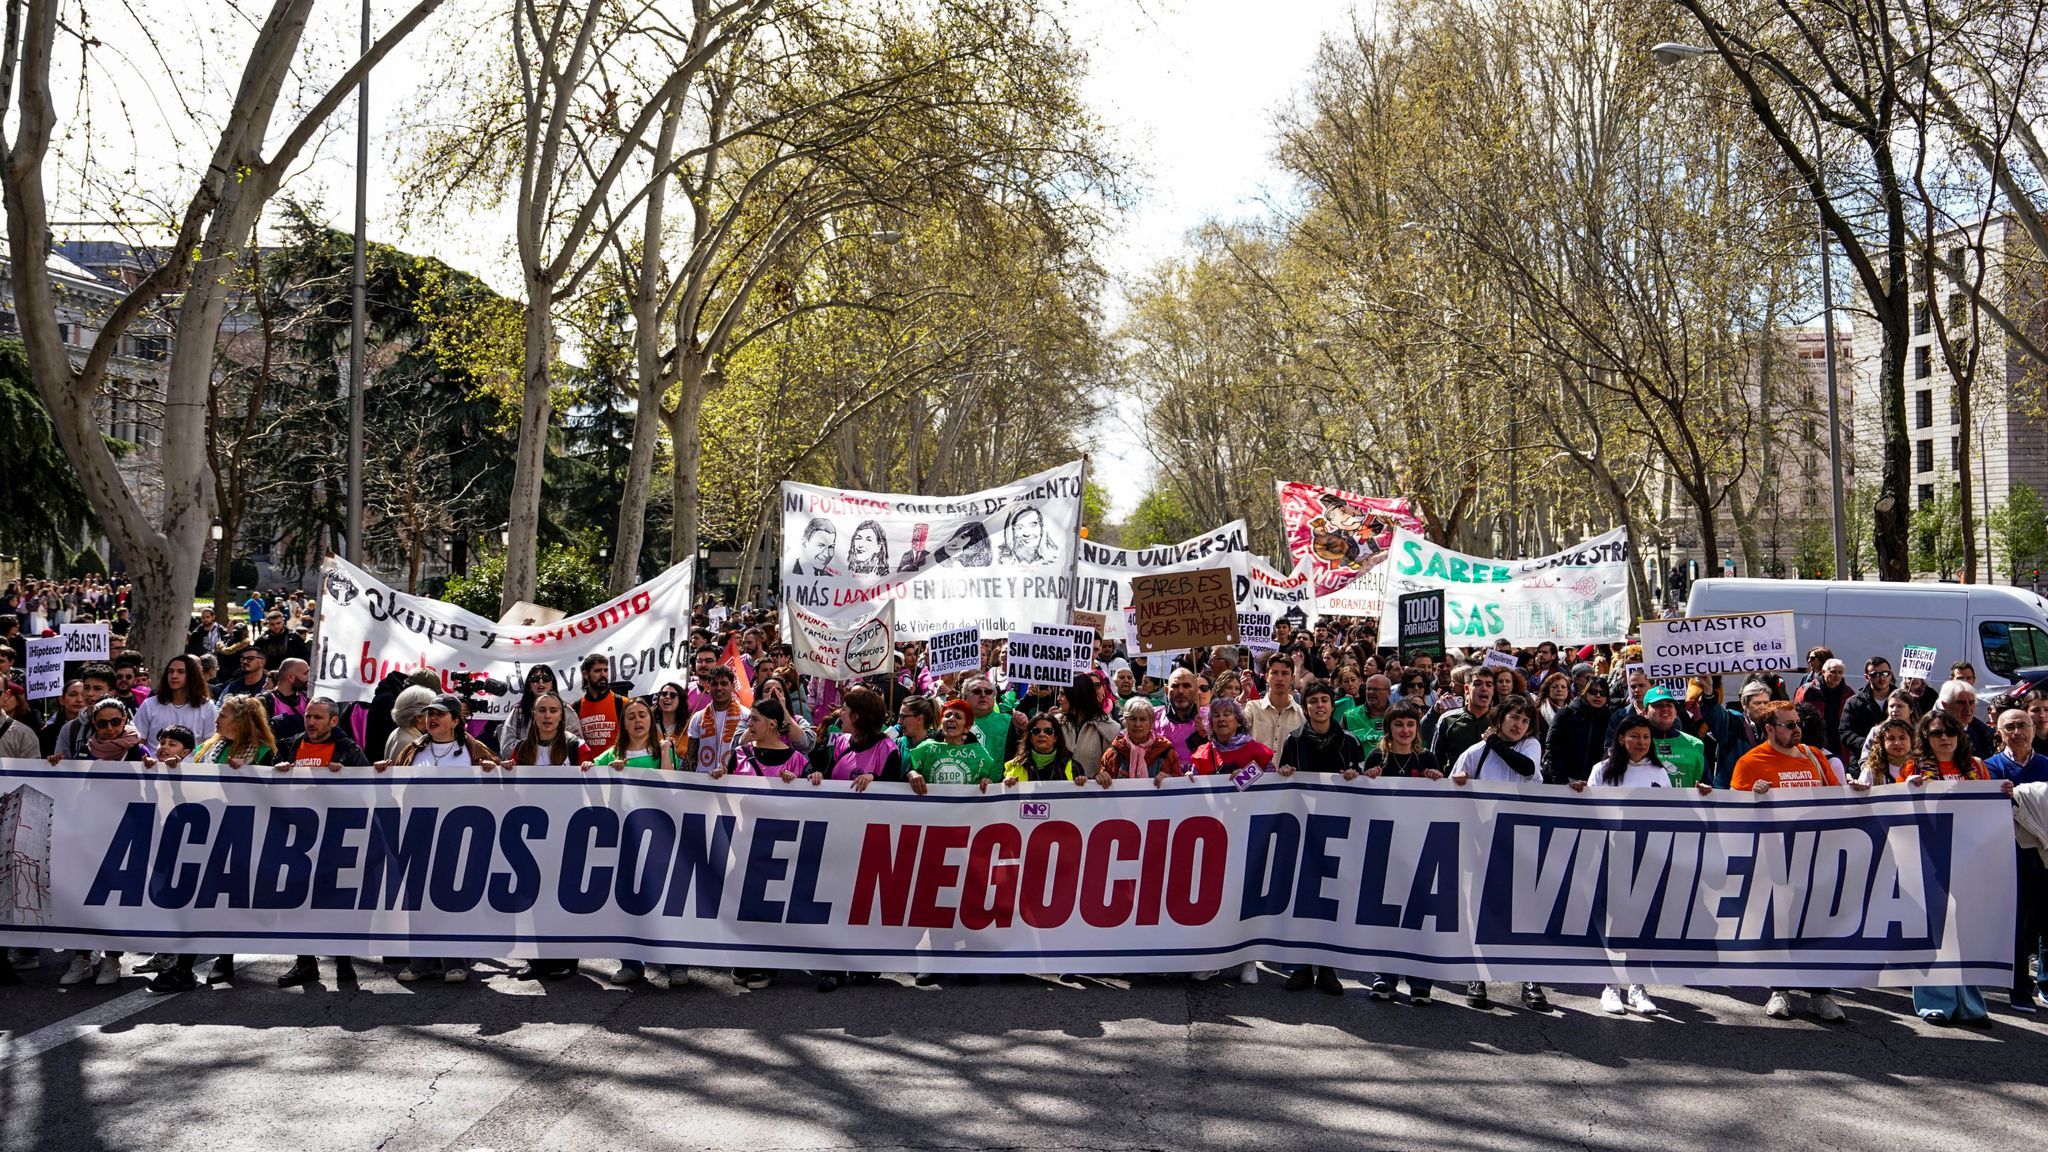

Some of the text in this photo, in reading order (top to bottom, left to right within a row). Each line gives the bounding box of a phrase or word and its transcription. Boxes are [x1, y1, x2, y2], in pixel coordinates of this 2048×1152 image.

[786, 492, 804, 512] NI
[1138, 529, 1249, 567] UNIVERSAL
[1137, 576, 1194, 600] SAREB
[1198, 574, 1223, 593] ES
[1251, 568, 1308, 589] IVIENDA
[796, 580, 829, 606] MÁS
[833, 582, 907, 607] LADRILLO
[914, 579, 935, 600] EN
[1006, 576, 1017, 598] Y
[1253, 586, 1310, 602] NIVERSAL
[1238, 613, 1271, 626] RECHO
[1404, 596, 1439, 624] TODO
[1447, 600, 1505, 637] SAS
[855, 623, 882, 646] STOP
[1404, 620, 1439, 636] POR HACER
[1667, 615, 1766, 633] CATASTRO
[930, 629, 978, 651] DERECHO
[1657, 641, 1782, 658] COMPLICE de la
[319, 636, 348, 680] la
[931, 643, 979, 666] A TECHO
[1009, 641, 1030, 658] SIN
[1031, 643, 1073, 662] CASA?
[936, 662, 954, 673] JUSTO
[1008, 663, 1072, 684] A LA CALLE!
[1651, 656, 1791, 677] ESPECULACION
[938, 771, 960, 781] STOP
[1778, 770, 1813, 780] SINDICATO
[83, 802, 1929, 940] ACABEMOS CON EL NEGOCIO DE LA VIVIENDA
